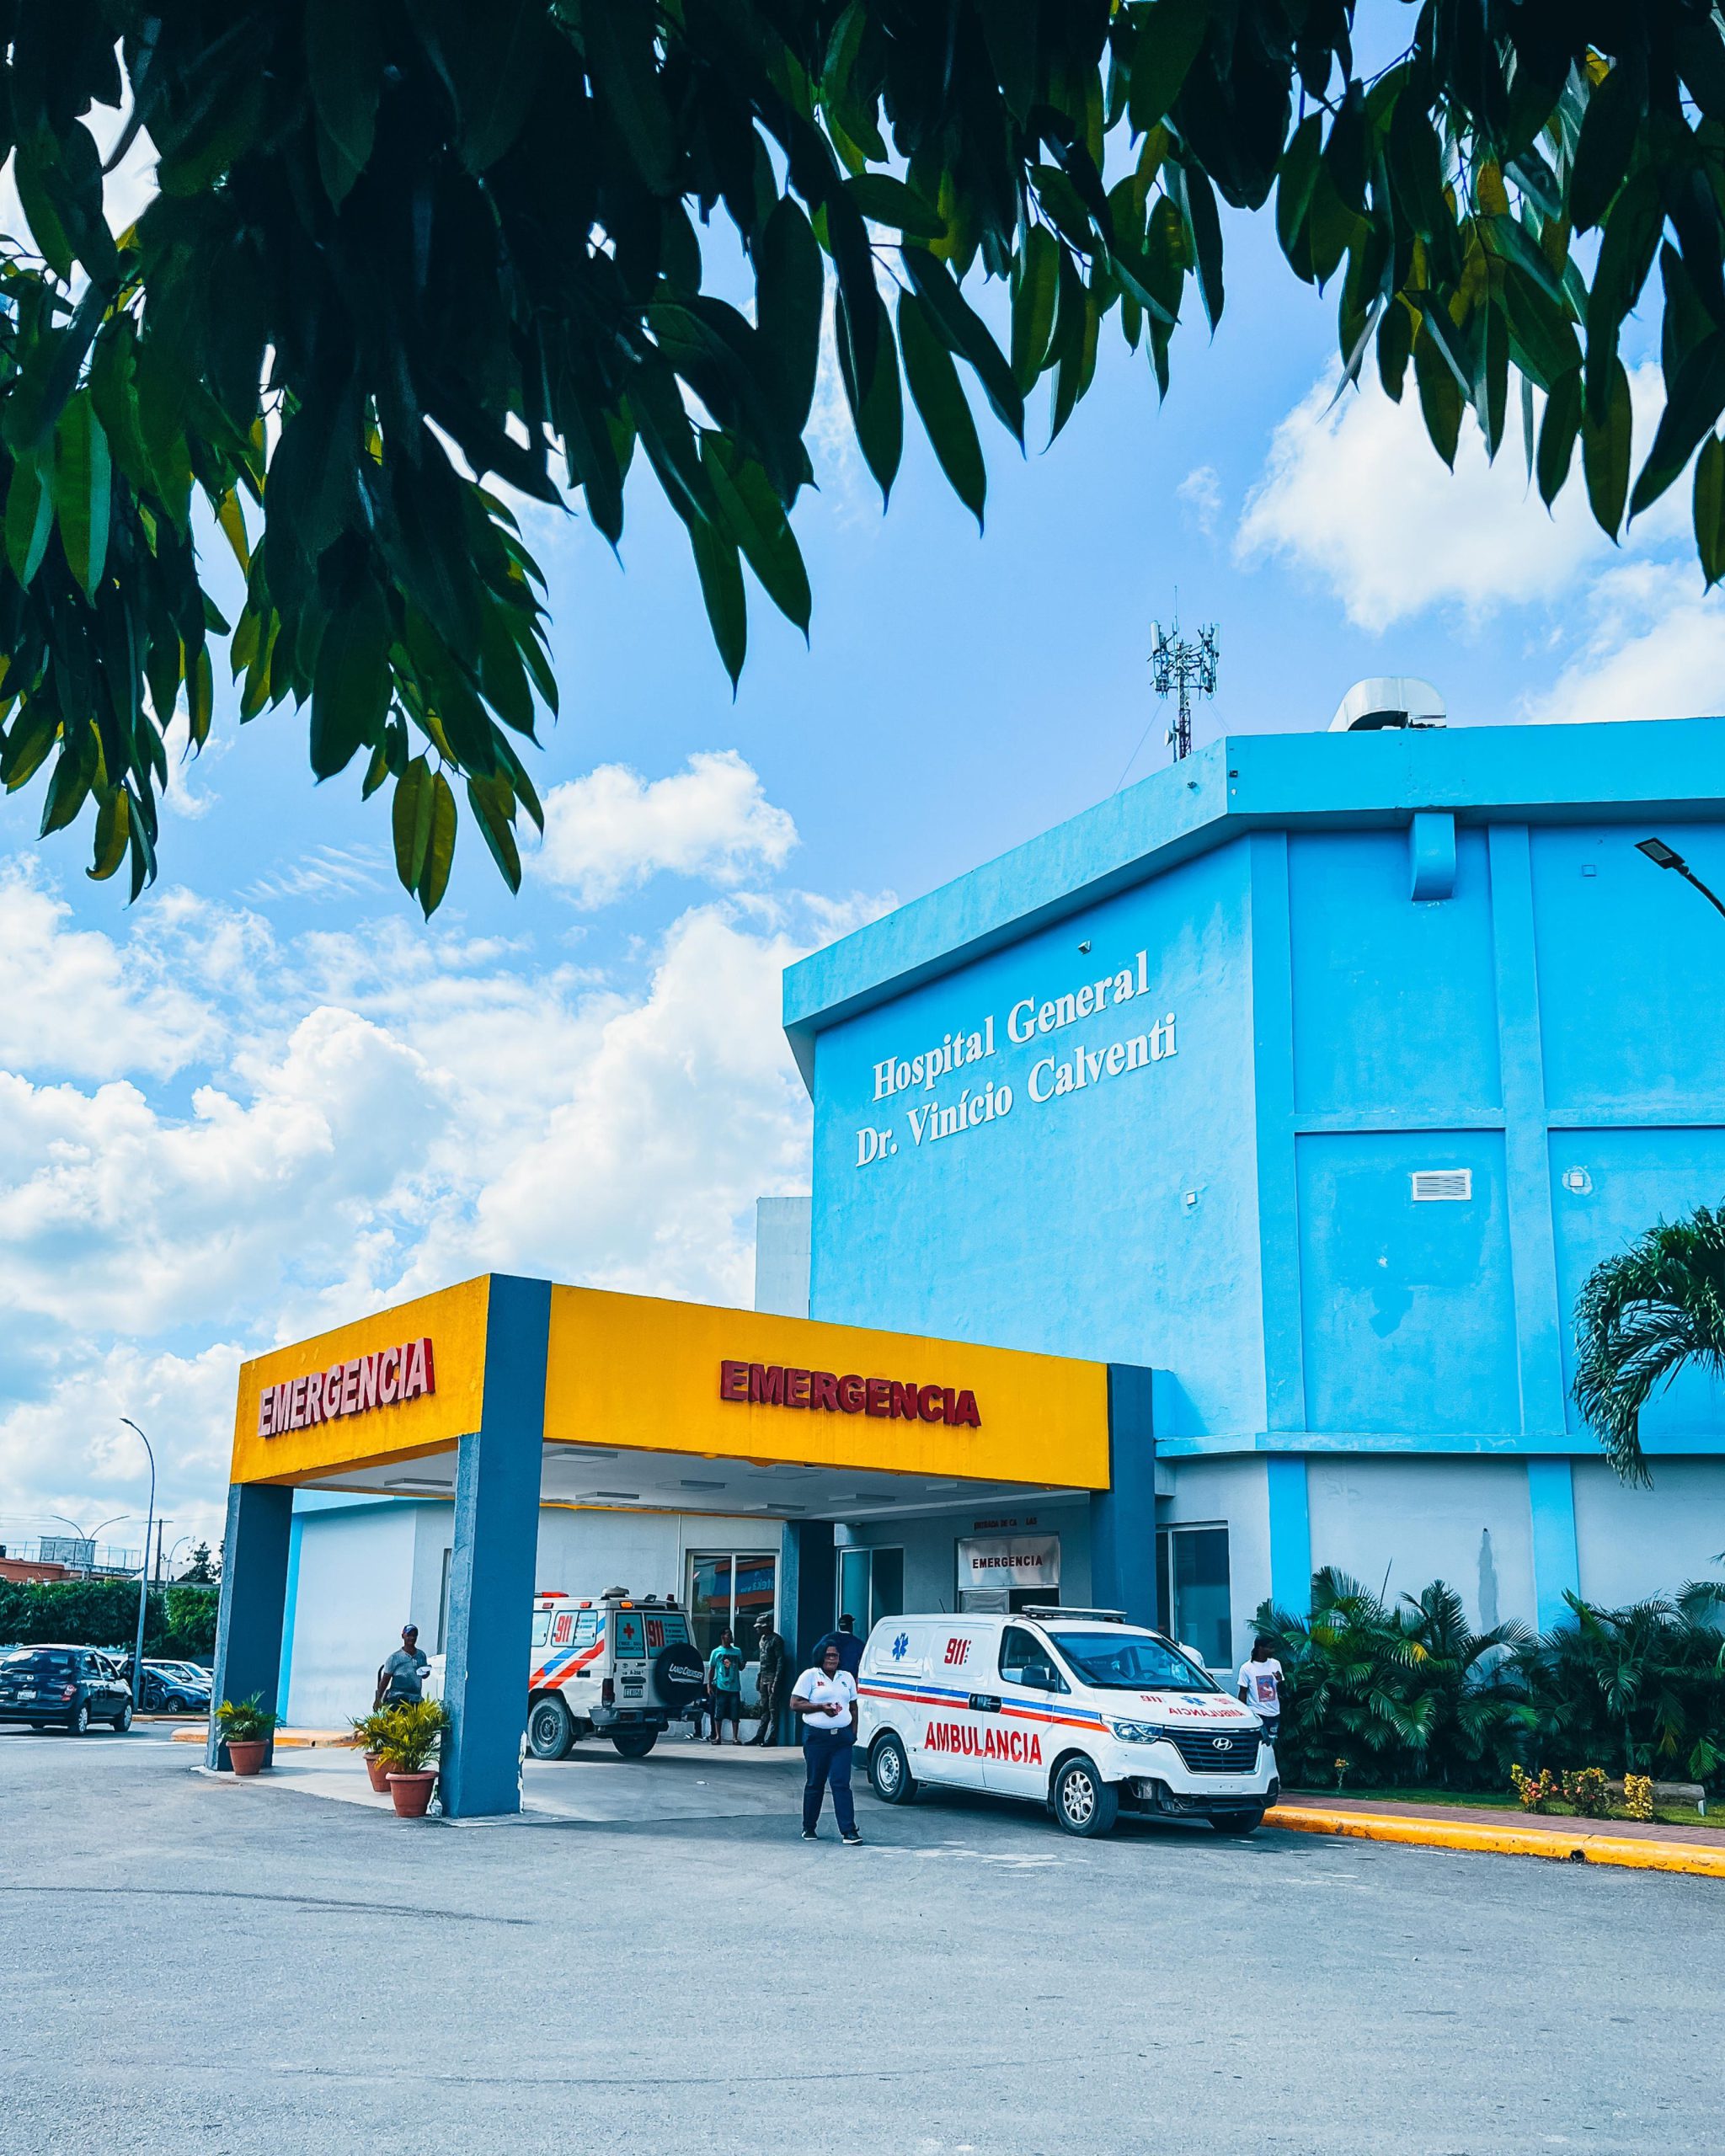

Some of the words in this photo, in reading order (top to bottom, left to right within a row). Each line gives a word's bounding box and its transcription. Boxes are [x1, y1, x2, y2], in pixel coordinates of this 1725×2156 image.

[872, 1015, 996, 1102] Hospital
[1007, 949, 1151, 1044] General
[856, 1126, 899, 1167] Dr.
[906, 1081, 1013, 1147] Vinício
[1028, 1012, 1178, 1103] Calventi
[258, 1337, 435, 1439] EMERGENCIA
[720, 1359, 982, 1428] EMERGENCIA
[972, 1555, 1044, 1569] EMERGENCIA
[554, 1615, 573, 1643] 911
[647, 1620, 665, 1647] 911
[669, 1662, 684, 1674] LAND
[944, 1638, 969, 1665] 911
[924, 1721, 1043, 1765] AMBULANCIA
